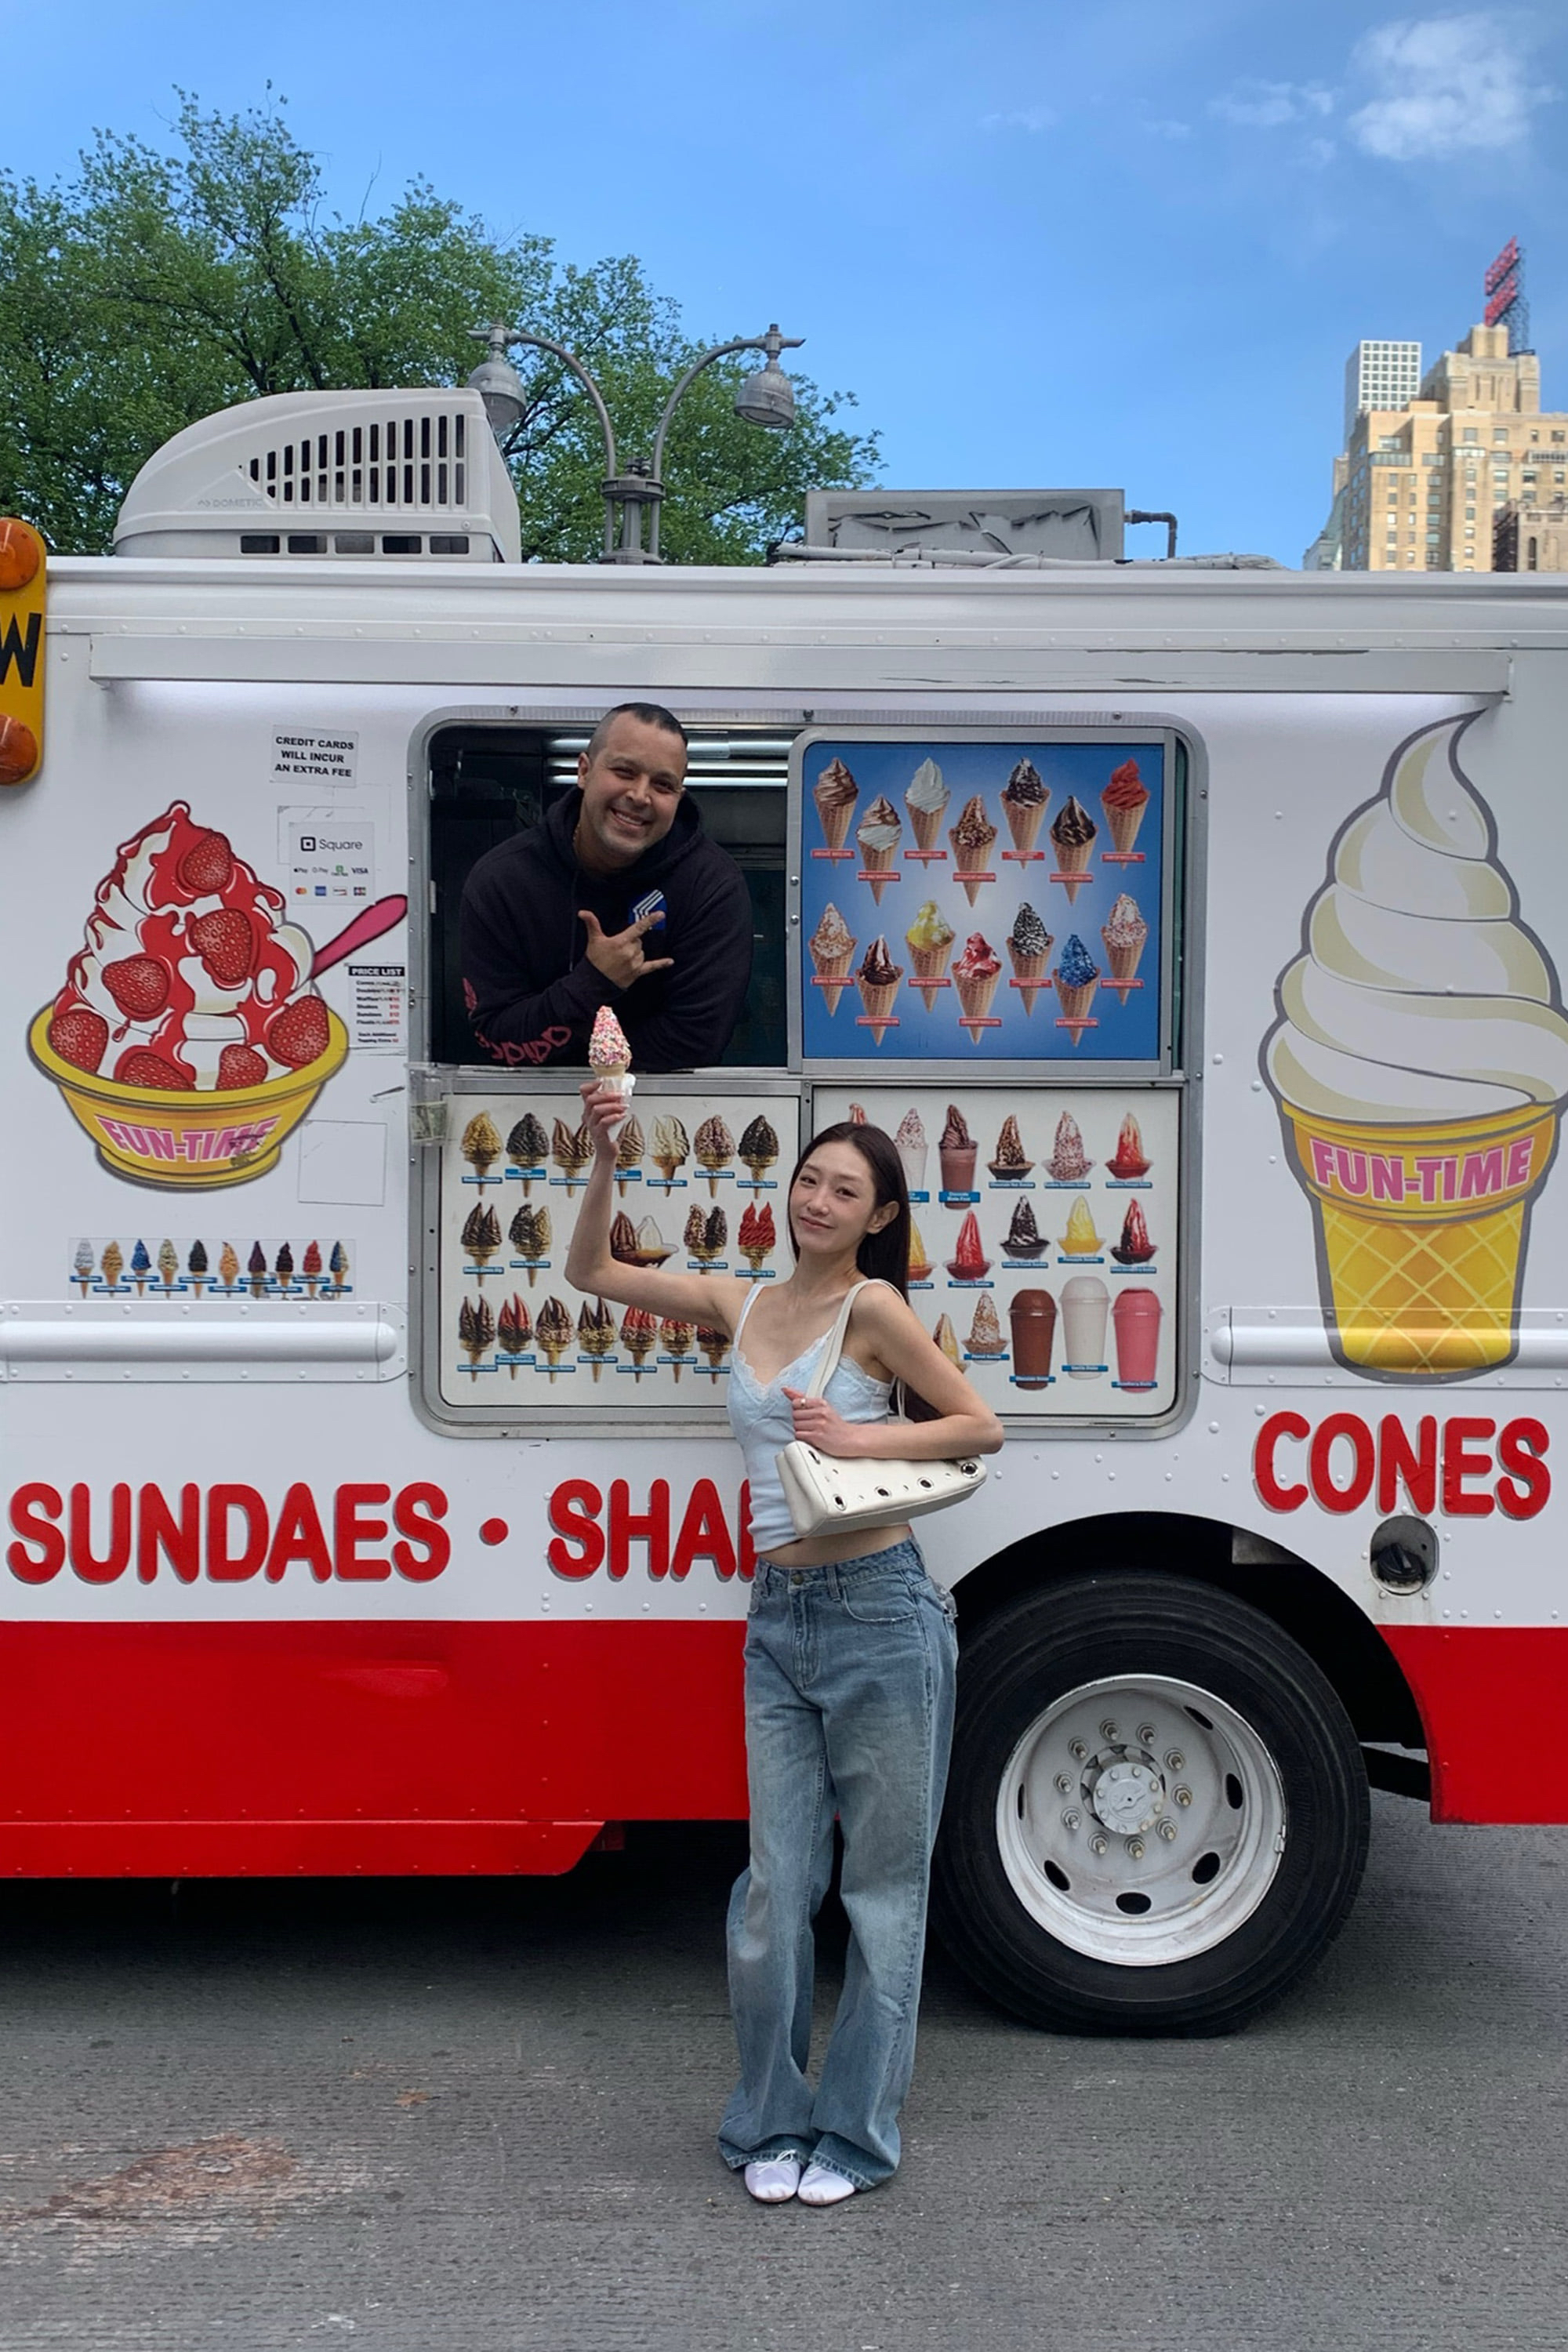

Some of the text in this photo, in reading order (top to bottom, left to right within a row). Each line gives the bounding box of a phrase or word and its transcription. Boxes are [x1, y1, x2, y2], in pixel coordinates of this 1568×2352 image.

[276, 736, 354, 750] CREDIT CARDS
[281, 750, 344, 764] WILL INCUR
[274, 764, 352, 777] AN EXTRA FEE
[319, 839, 363, 851] Square
[352, 967, 379, 976] PRICE
[1309, 1135, 1535, 1203] FUN-TIME
[1254, 1411, 1551, 1519] CONES
[6, 1482, 450, 1582] SUNDAES
